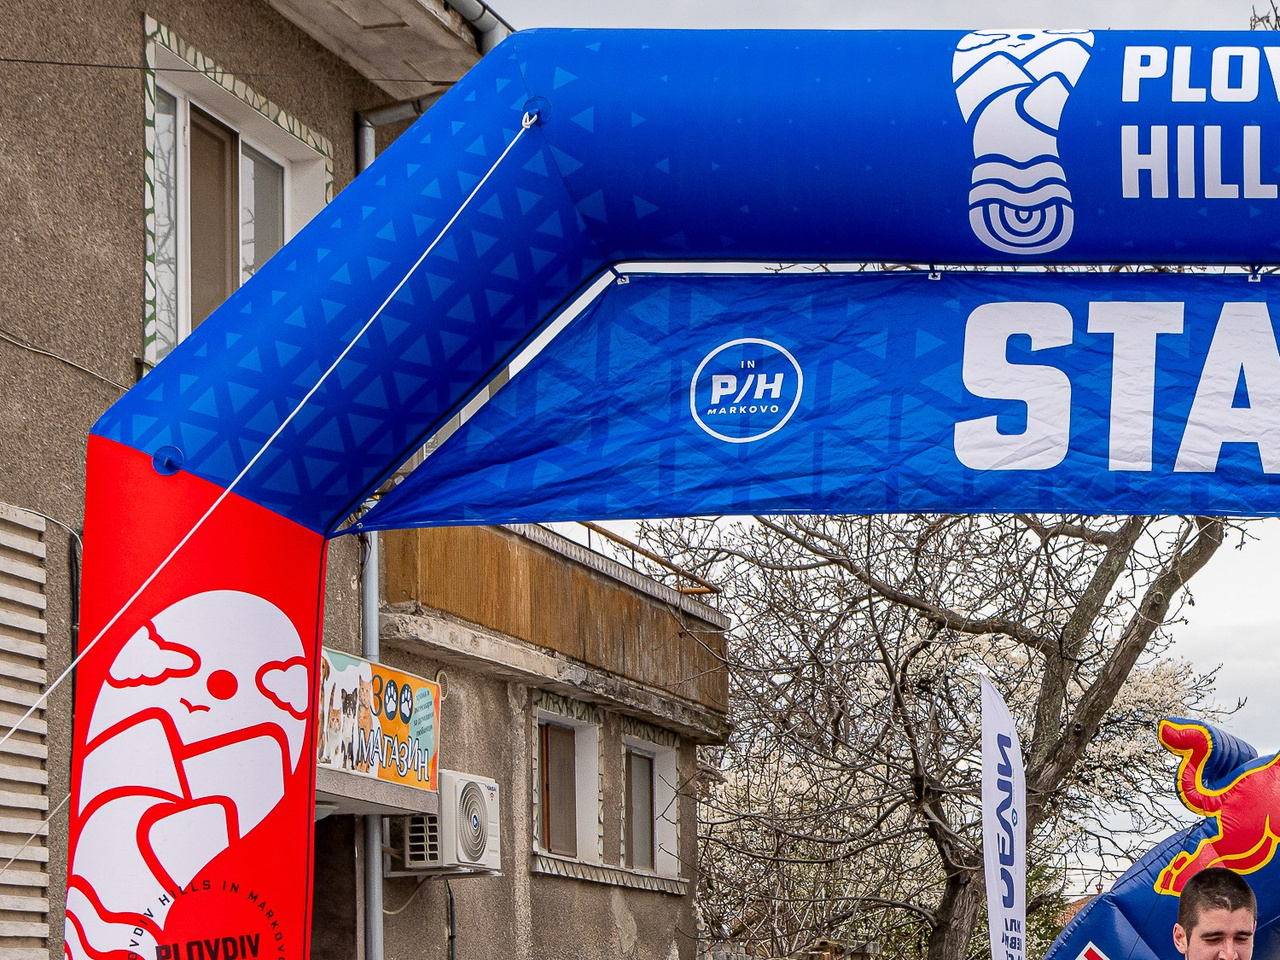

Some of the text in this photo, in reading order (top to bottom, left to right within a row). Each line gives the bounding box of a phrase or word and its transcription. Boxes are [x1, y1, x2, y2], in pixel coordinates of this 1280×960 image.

[741, 360, 755, 369] IN
[711, 373, 784, 405] P/H
[707, 404, 779, 415] MARKOVO
[359, 727, 429, 782] МАГАЗИН
[158, 880, 211, 906] HILLS
[223, 881, 239, 892] IN
